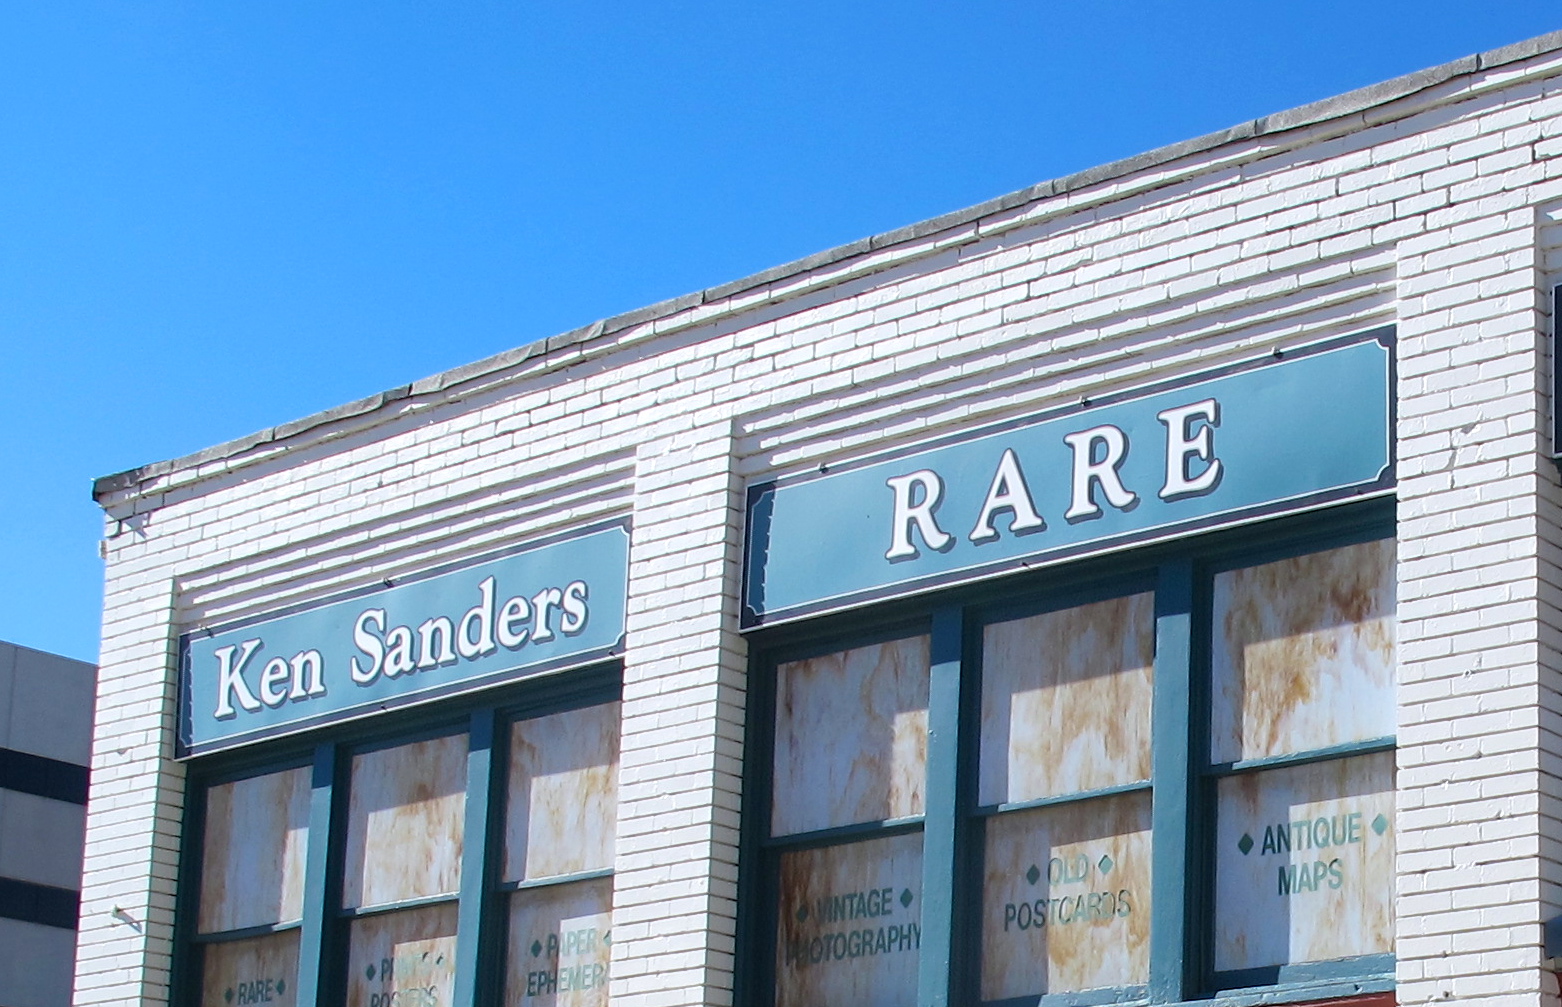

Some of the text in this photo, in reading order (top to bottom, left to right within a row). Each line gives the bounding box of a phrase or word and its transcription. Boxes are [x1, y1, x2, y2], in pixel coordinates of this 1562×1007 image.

[885, 398, 1224, 564] RARE
[213, 575, 590, 720] Ken Sanders
[1261, 812, 1362, 856] ANTIQUE
[1047, 853, 1089, 885] OLD
[1278, 857, 1343, 896] MAPS
[817, 887, 893, 924] VINTAGE
[1004, 889, 1131, 932] POSTCARDS
[547, 928, 597, 959] PAPER
[238, 978, 273, 1005] RARE
[527, 963, 611, 997] EPHEMER
